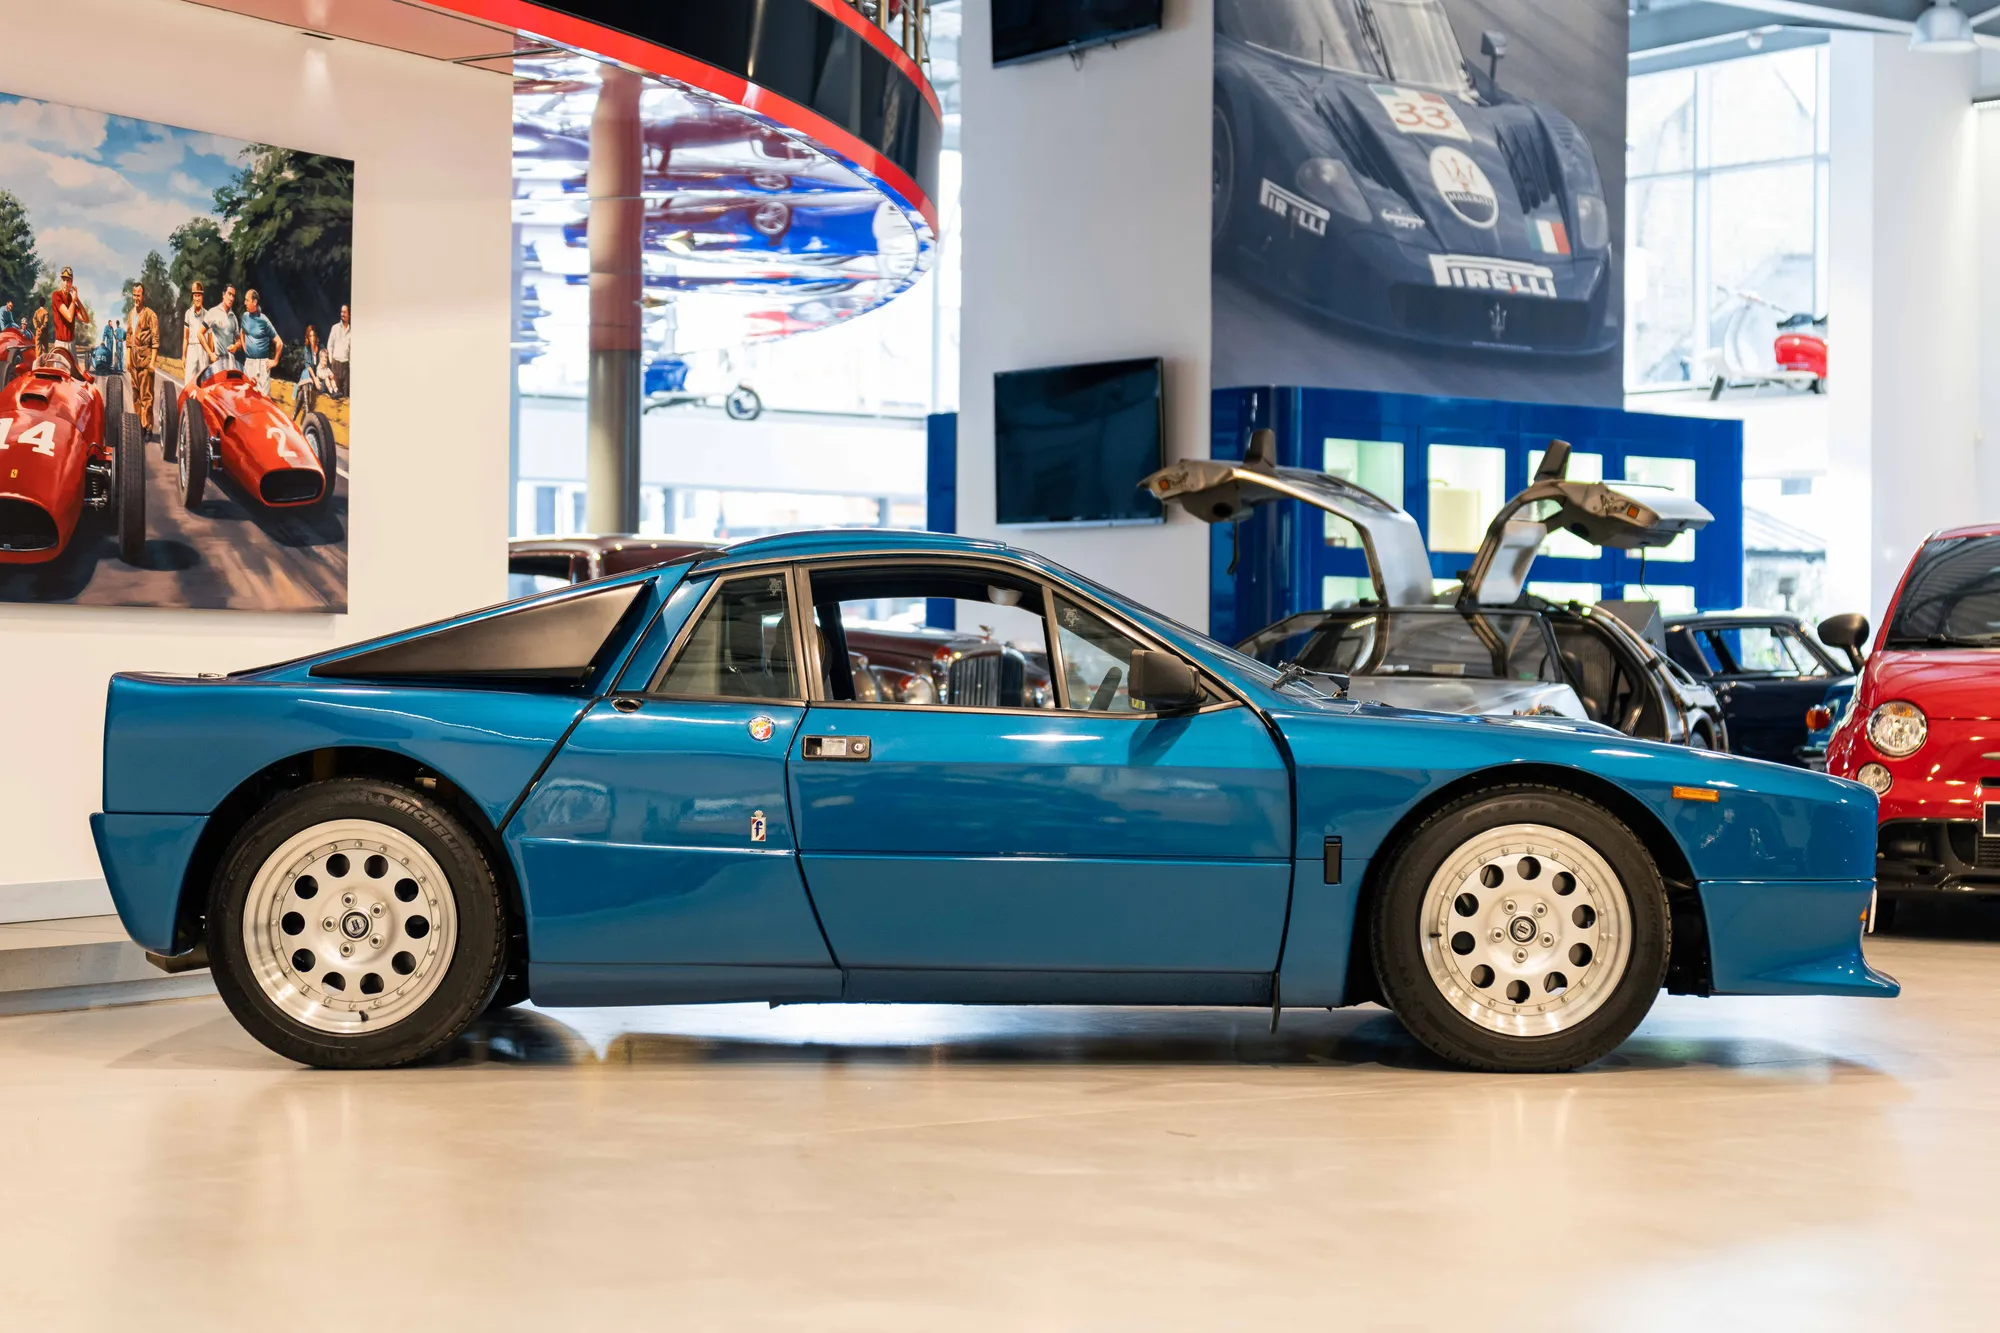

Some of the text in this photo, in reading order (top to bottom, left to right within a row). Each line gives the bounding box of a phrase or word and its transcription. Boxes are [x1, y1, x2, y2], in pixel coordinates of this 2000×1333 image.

[1394, 102, 1451, 130] 33
[1260, 177, 1331, 236] PIRLLI
[1429, 254, 1557, 298] PIRELLI
[0, 417, 56, 457] 14
[266, 427, 298, 458] 2
[386, 798, 468, 864] MICHELIN
